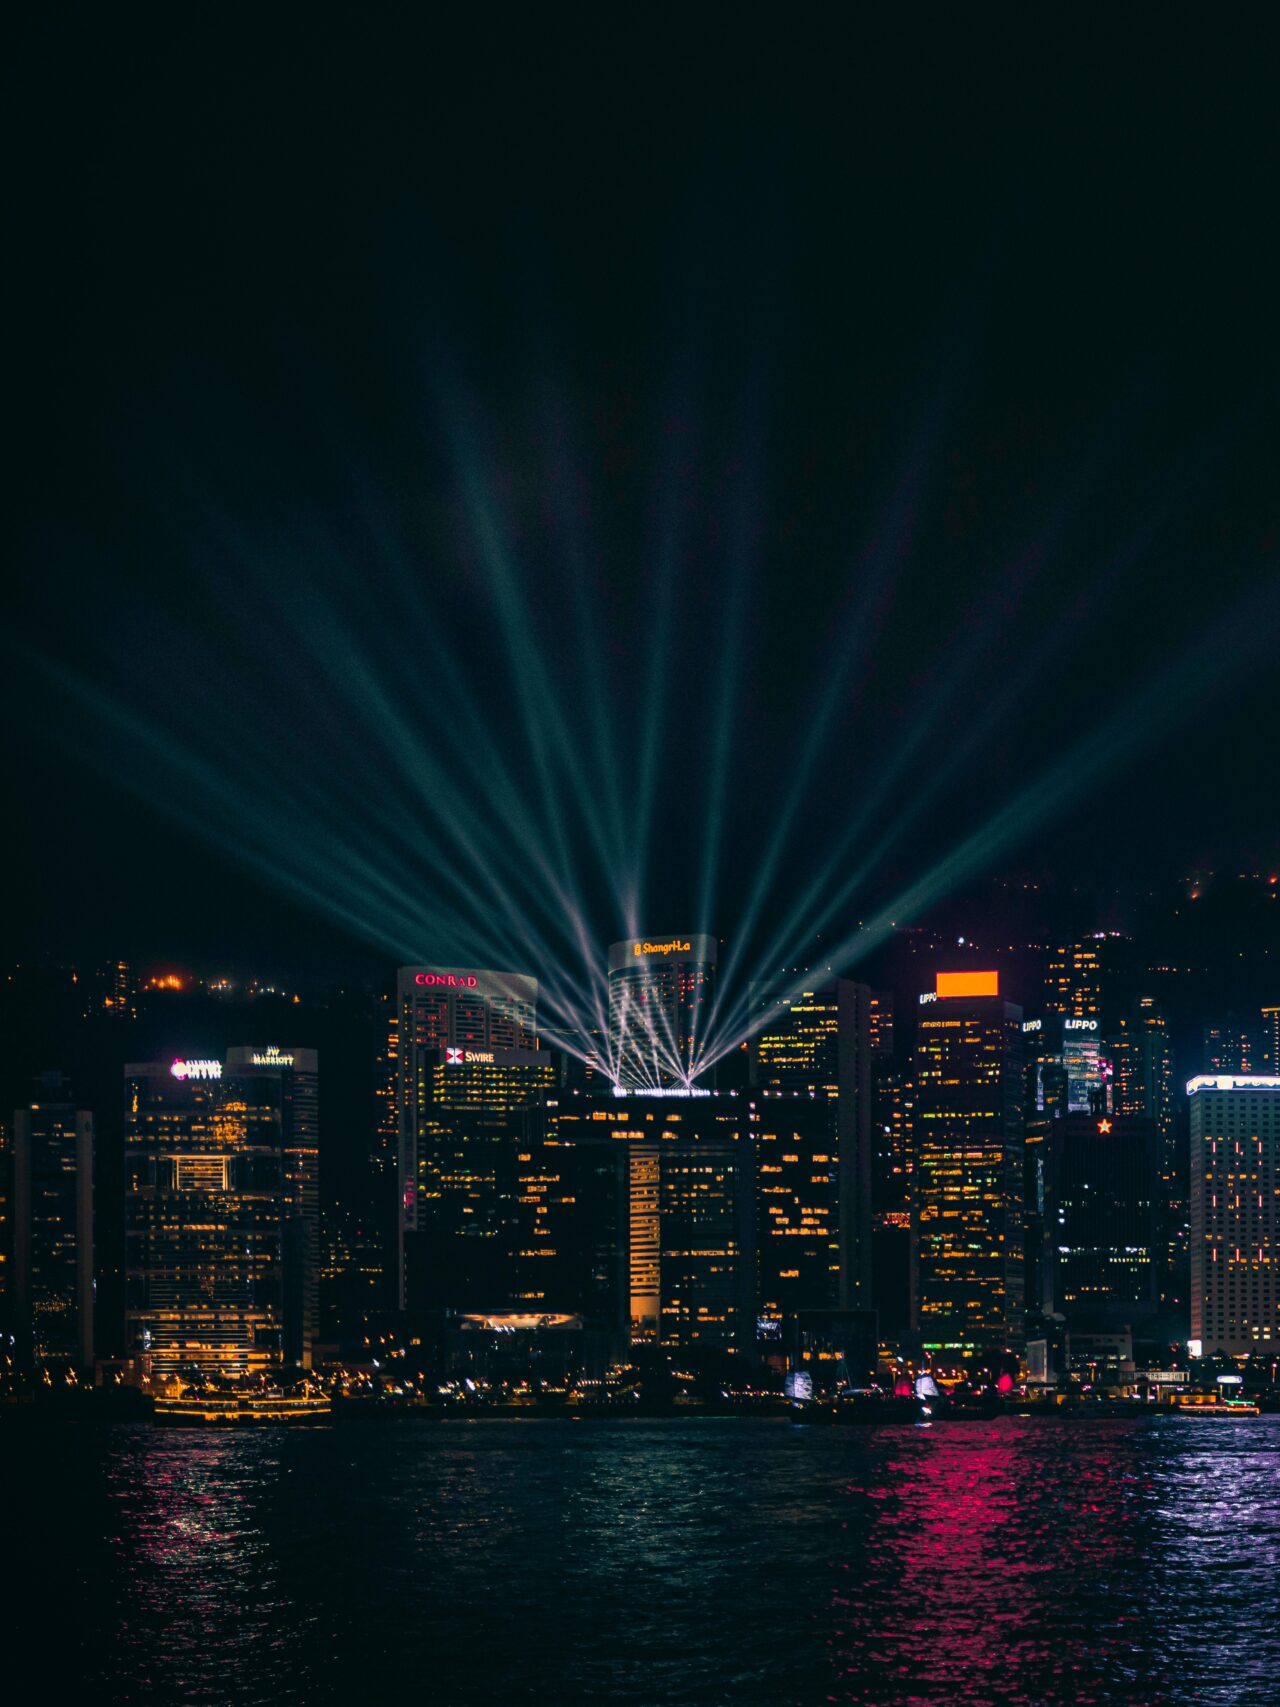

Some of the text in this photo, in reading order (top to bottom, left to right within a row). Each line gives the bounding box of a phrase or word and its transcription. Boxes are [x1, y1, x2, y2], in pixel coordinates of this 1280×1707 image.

[415, 973, 477, 987] CONRAD
[920, 992, 937, 1004] LIPPO
[1022, 1020, 1041, 1032] LIPPO
[1065, 1020, 1097, 1030] LIPPO
[266, 1047, 280, 1056] JW
